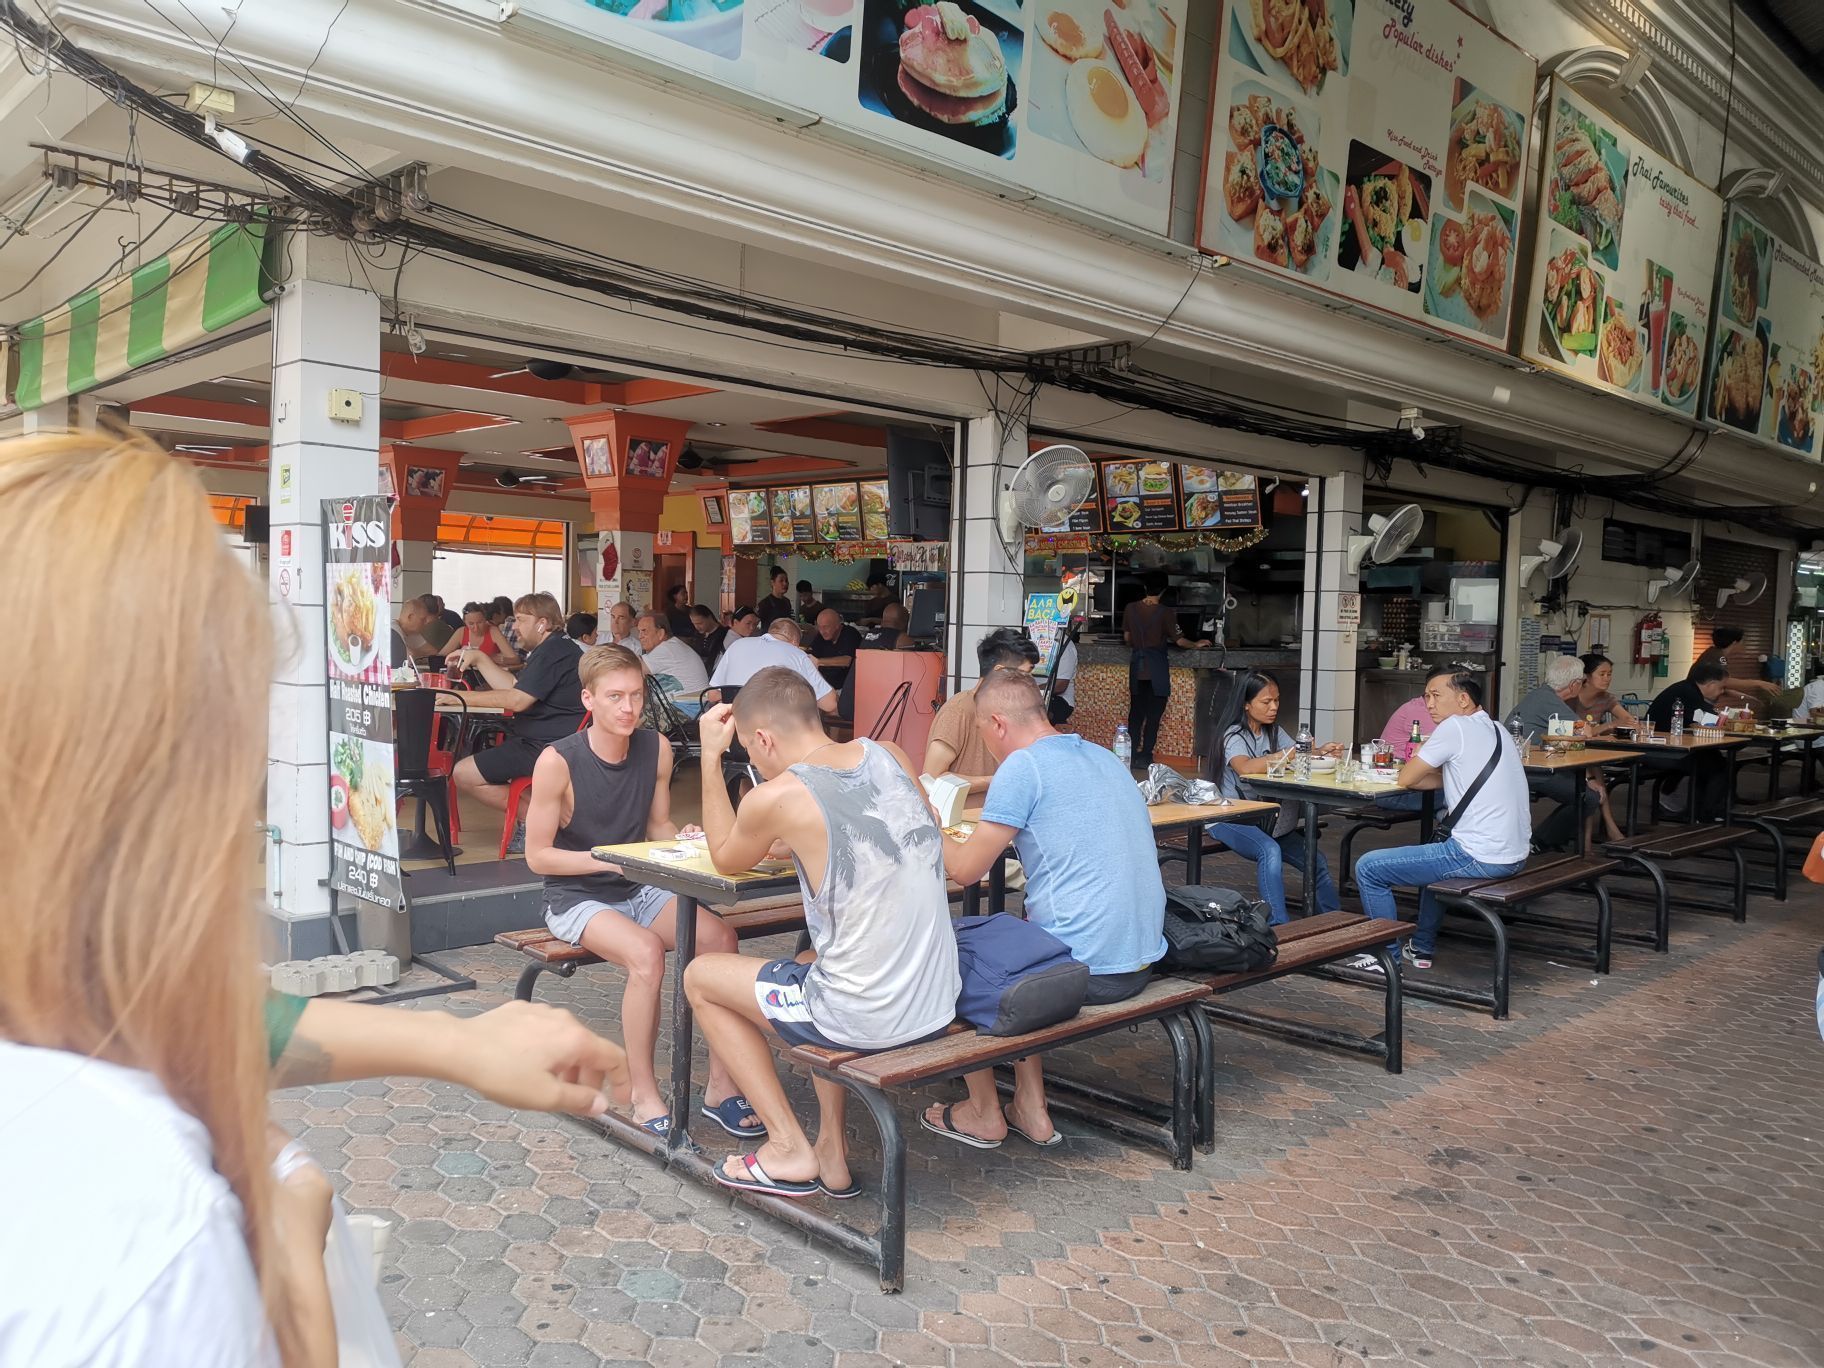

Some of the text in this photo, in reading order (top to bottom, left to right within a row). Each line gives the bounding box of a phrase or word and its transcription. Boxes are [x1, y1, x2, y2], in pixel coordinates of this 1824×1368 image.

[1383, 18, 1454, 73] Popular dishes
[1632, 156, 1689, 206] Thai Favourites
[362, 684, 390, 708] Chicken
[345, 707, 361, 723] 205
[348, 866, 367, 883] 240
